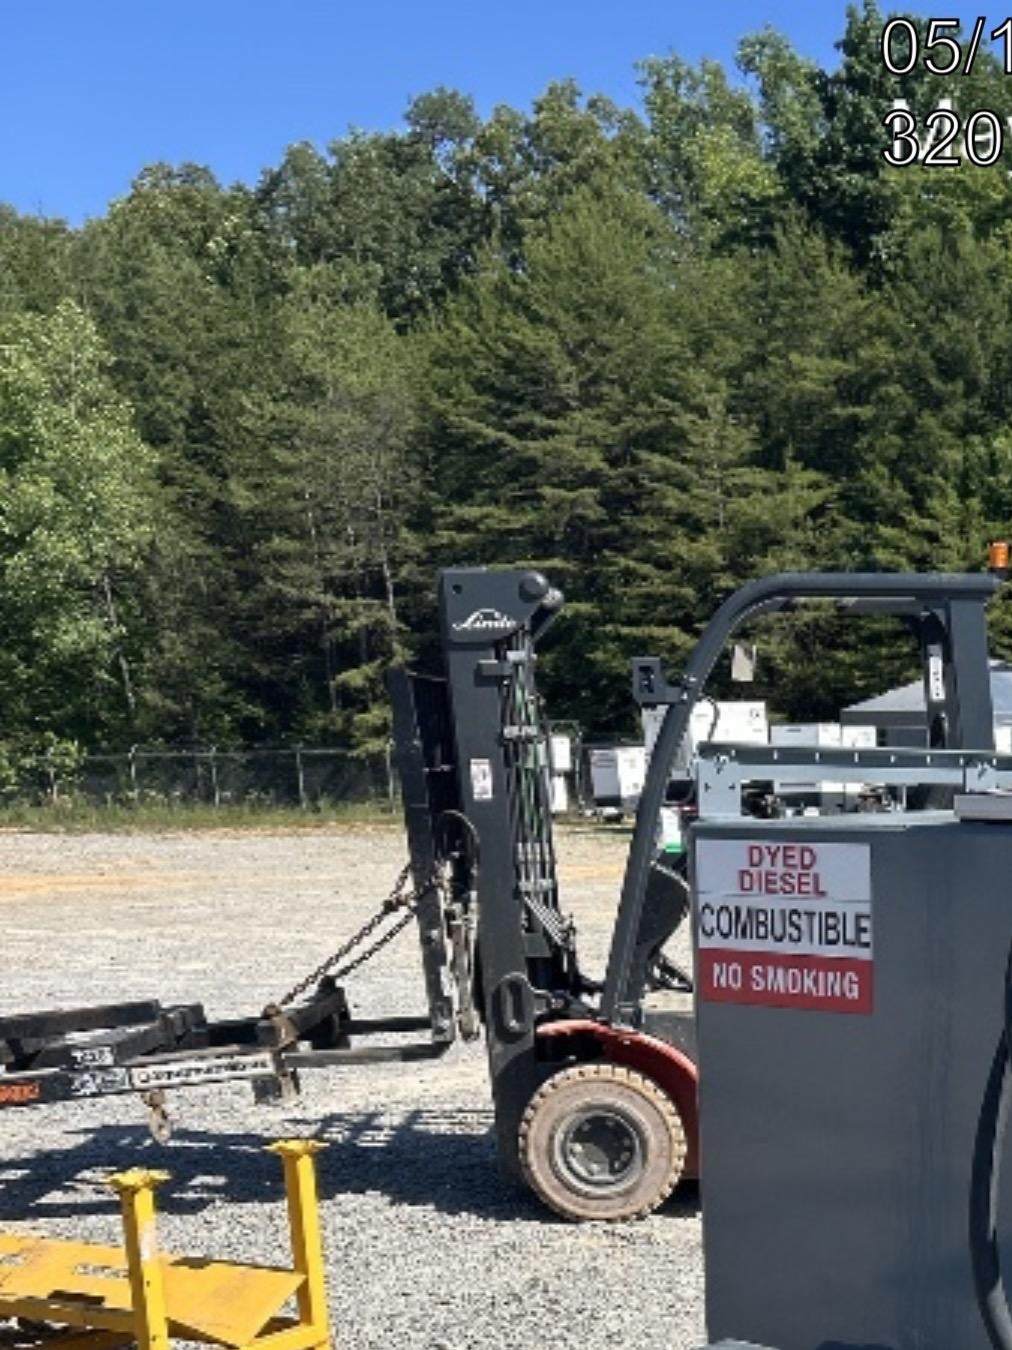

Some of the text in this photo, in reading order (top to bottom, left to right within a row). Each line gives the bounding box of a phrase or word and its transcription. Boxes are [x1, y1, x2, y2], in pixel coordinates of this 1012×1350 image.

[747, 845, 818, 871] DYED
[738, 869, 828, 898] DIESEL
[700, 902, 872, 949] COMBUSTIBLE
[712, 961, 860, 1001] NO SMOKING
